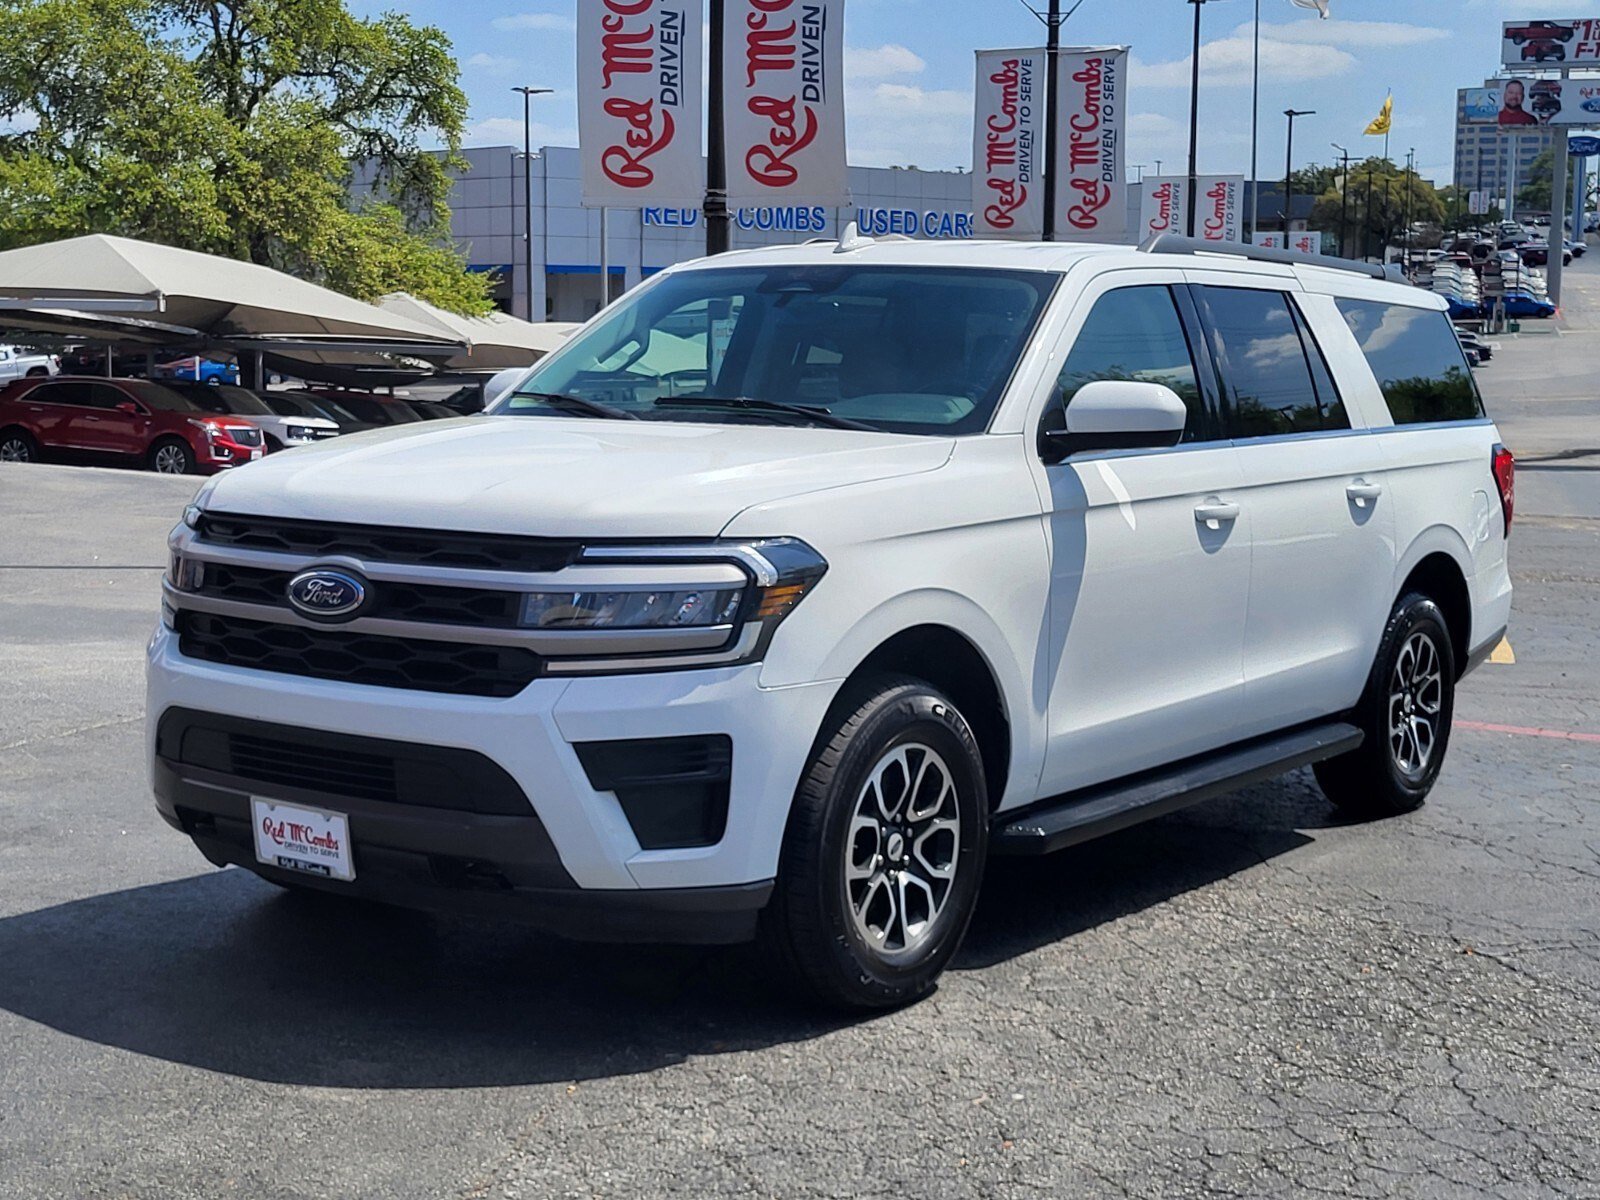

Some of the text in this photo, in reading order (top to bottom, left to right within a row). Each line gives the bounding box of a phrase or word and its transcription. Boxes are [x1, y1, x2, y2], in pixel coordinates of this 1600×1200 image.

[660, 10, 679, 106] DRIVEN
[802, 5, 820, 102] DRIVEN
[1019, 58, 1032, 183] DRIVEN TO SERVE
[1102, 58, 1115, 182] DRIVEN TO SERVE
[602, 97, 675, 188] Red
[745, 95, 818, 187] Red
[984, 59, 1027, 229] Red McCombs
[1067, 58, 1110, 229] Red McCombs
[1568, 141, 1597, 152] Ford
[1149, 182, 1171, 232] Combs
[1172, 183, 1180, 210] SERVE
[1227, 181, 1235, 210] SERVE
[643, 207, 698, 227] RED
[738, 207, 826, 231] COMBS
[858, 208, 918, 235] USED
[1171, 213, 1179, 227] TO
[1226, 213, 1234, 226] TO
[302, 579, 344, 605] Ford
[263, 817, 339, 850] Red McCombs
[284, 841, 339, 859] DRIVEN TO SERVE
